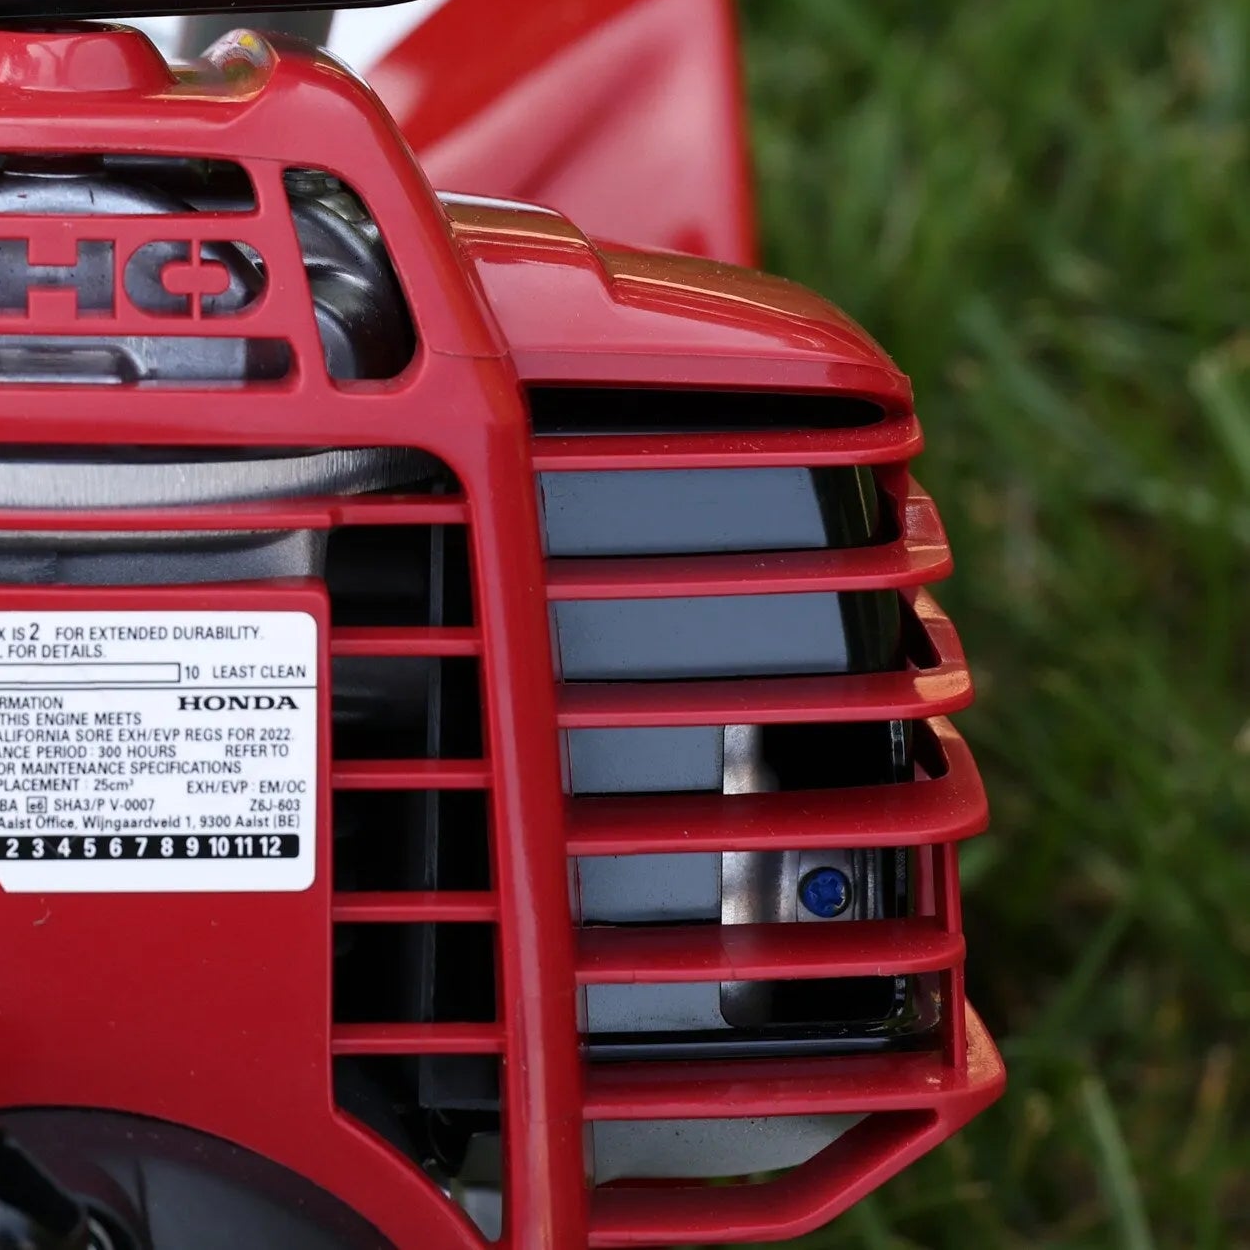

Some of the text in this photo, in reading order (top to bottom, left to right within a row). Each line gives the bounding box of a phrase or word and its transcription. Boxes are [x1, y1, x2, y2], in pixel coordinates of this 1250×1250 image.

[12, 627, 25, 640] IS
[30, 623, 40, 640] 2
[55, 627, 83, 641] FOR
[90, 626, 168, 640] EXTENDED
[174, 626, 263, 640] DURABILITY.
[8, 644, 36, 658] FOR
[42, 644, 107, 658] DETAILS.
[185, 666, 200, 679] 10
[212, 666, 255, 679] LEAST
[261, 666, 306, 679] CLEAN
[178, 696, 299, 711] HONDA
[0, 713, 30, 725] THIS
[37, 713, 88, 725] ENGINE
[94, 713, 141, 725] MEETS
[76, 729, 113, 741] SORE
[119, 729, 180, 741] EXH/EVP
[185, 728, 223, 742] REGS
[228, 728, 255, 741] FOR
[37, 746, 86, 758] PERIOD
[98, 745, 121, 758] 300
[127, 745, 176, 758] HOURS
[225, 744, 269, 757] REFER
[271, 744, 289, 757] TO
[21, 762, 125, 774] MAINTENANCE
[130, 761, 242, 774] SPECIFICATIONS
[186, 781, 248, 794] EXH/EVP
[259, 780, 306, 793] EM/OC
[54, 799, 104, 811] SHA3/P
[110, 799, 155, 811] V-0007
[35, 816, 78, 830] Office,
[83, 816, 180, 832] Wijngaardveld
[200, 815, 231, 828] 9300
[235, 815, 269, 828] Aalst
[6, 838, 19, 858] 2
[31, 838, 45, 858] 3
[57, 838, 72, 858] 4
[83, 838, 97, 858] 5
[109, 837, 123, 857] 6
[135, 837, 148, 857] 7
[160, 837, 174, 857] 8
[185, 837, 200, 857] 9
[208, 837, 230, 857] 10
[234, 837, 252, 857] 11
[258, 837, 282, 857] 12
